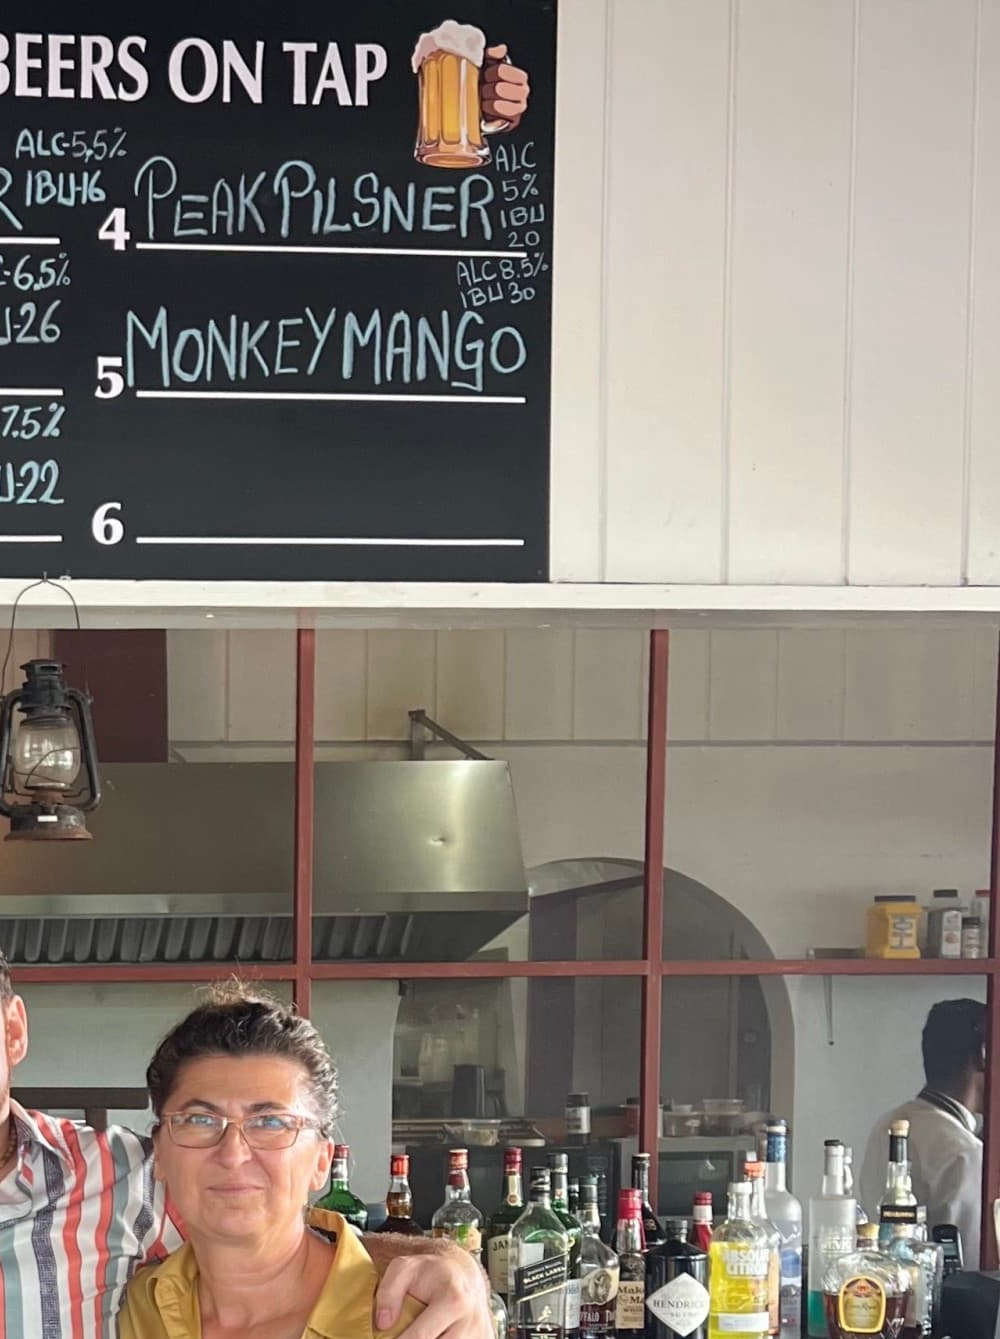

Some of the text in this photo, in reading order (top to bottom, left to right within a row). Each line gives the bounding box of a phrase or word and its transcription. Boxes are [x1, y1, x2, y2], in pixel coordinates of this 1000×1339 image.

[167, 37, 265, 105] ON
[282, 41, 388, 107] TAP
[495, 141, 537, 172] ALC
[134, 156, 495, 241] PEAK PILSNER
[502, 173, 539, 201] 5%
[98, 207, 131, 251] 4
[501, 203, 545, 229] IBU
[508, 231, 540, 247] 20
[456, 252, 549, 288] ALC 8.5%
[460, 282, 536, 308] IBU 30
[126, 306, 527, 392] MONKEY MANGO
[94, 355, 124, 399] 5
[91, 502, 124, 545] 6
